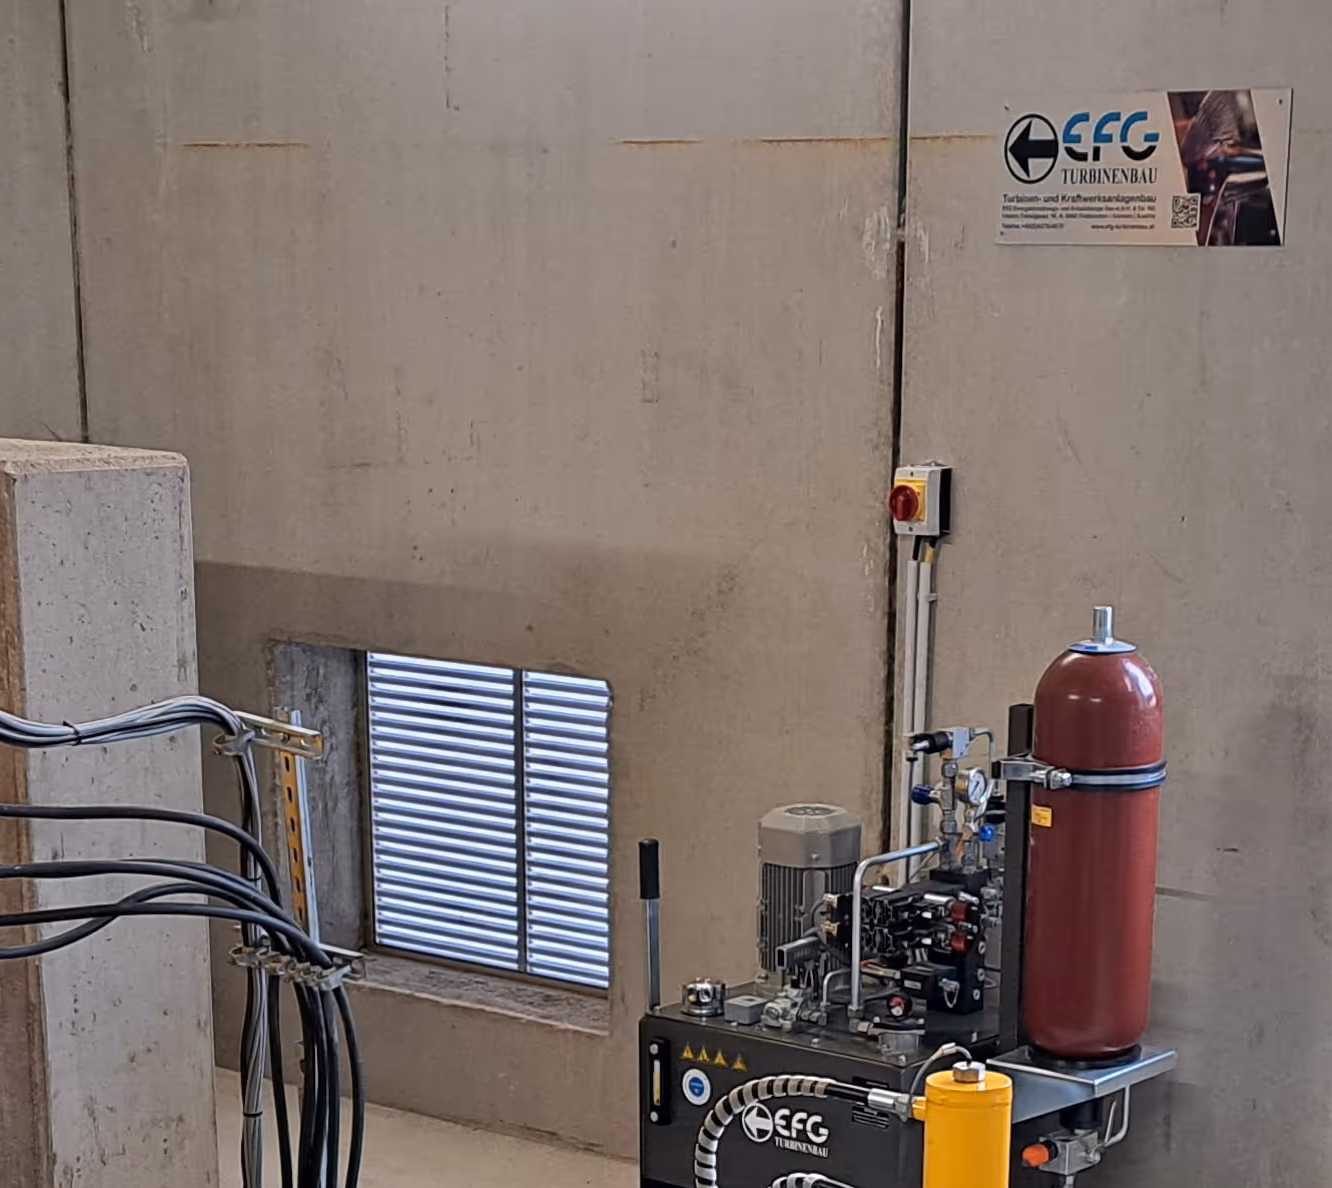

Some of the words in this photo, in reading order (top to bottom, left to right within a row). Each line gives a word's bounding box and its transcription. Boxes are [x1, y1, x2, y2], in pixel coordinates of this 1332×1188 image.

[1062, 111, 1160, 162] EFG
[1061, 168, 1158, 185] TURBINENBAU
[1043, 193, 1059, 202] und
[1061, 193, 1157, 204] Kraftwerksanlagenbau
[774, 1108, 829, 1144] EFG
[774, 1136, 829, 1158] TURBINENBAU
